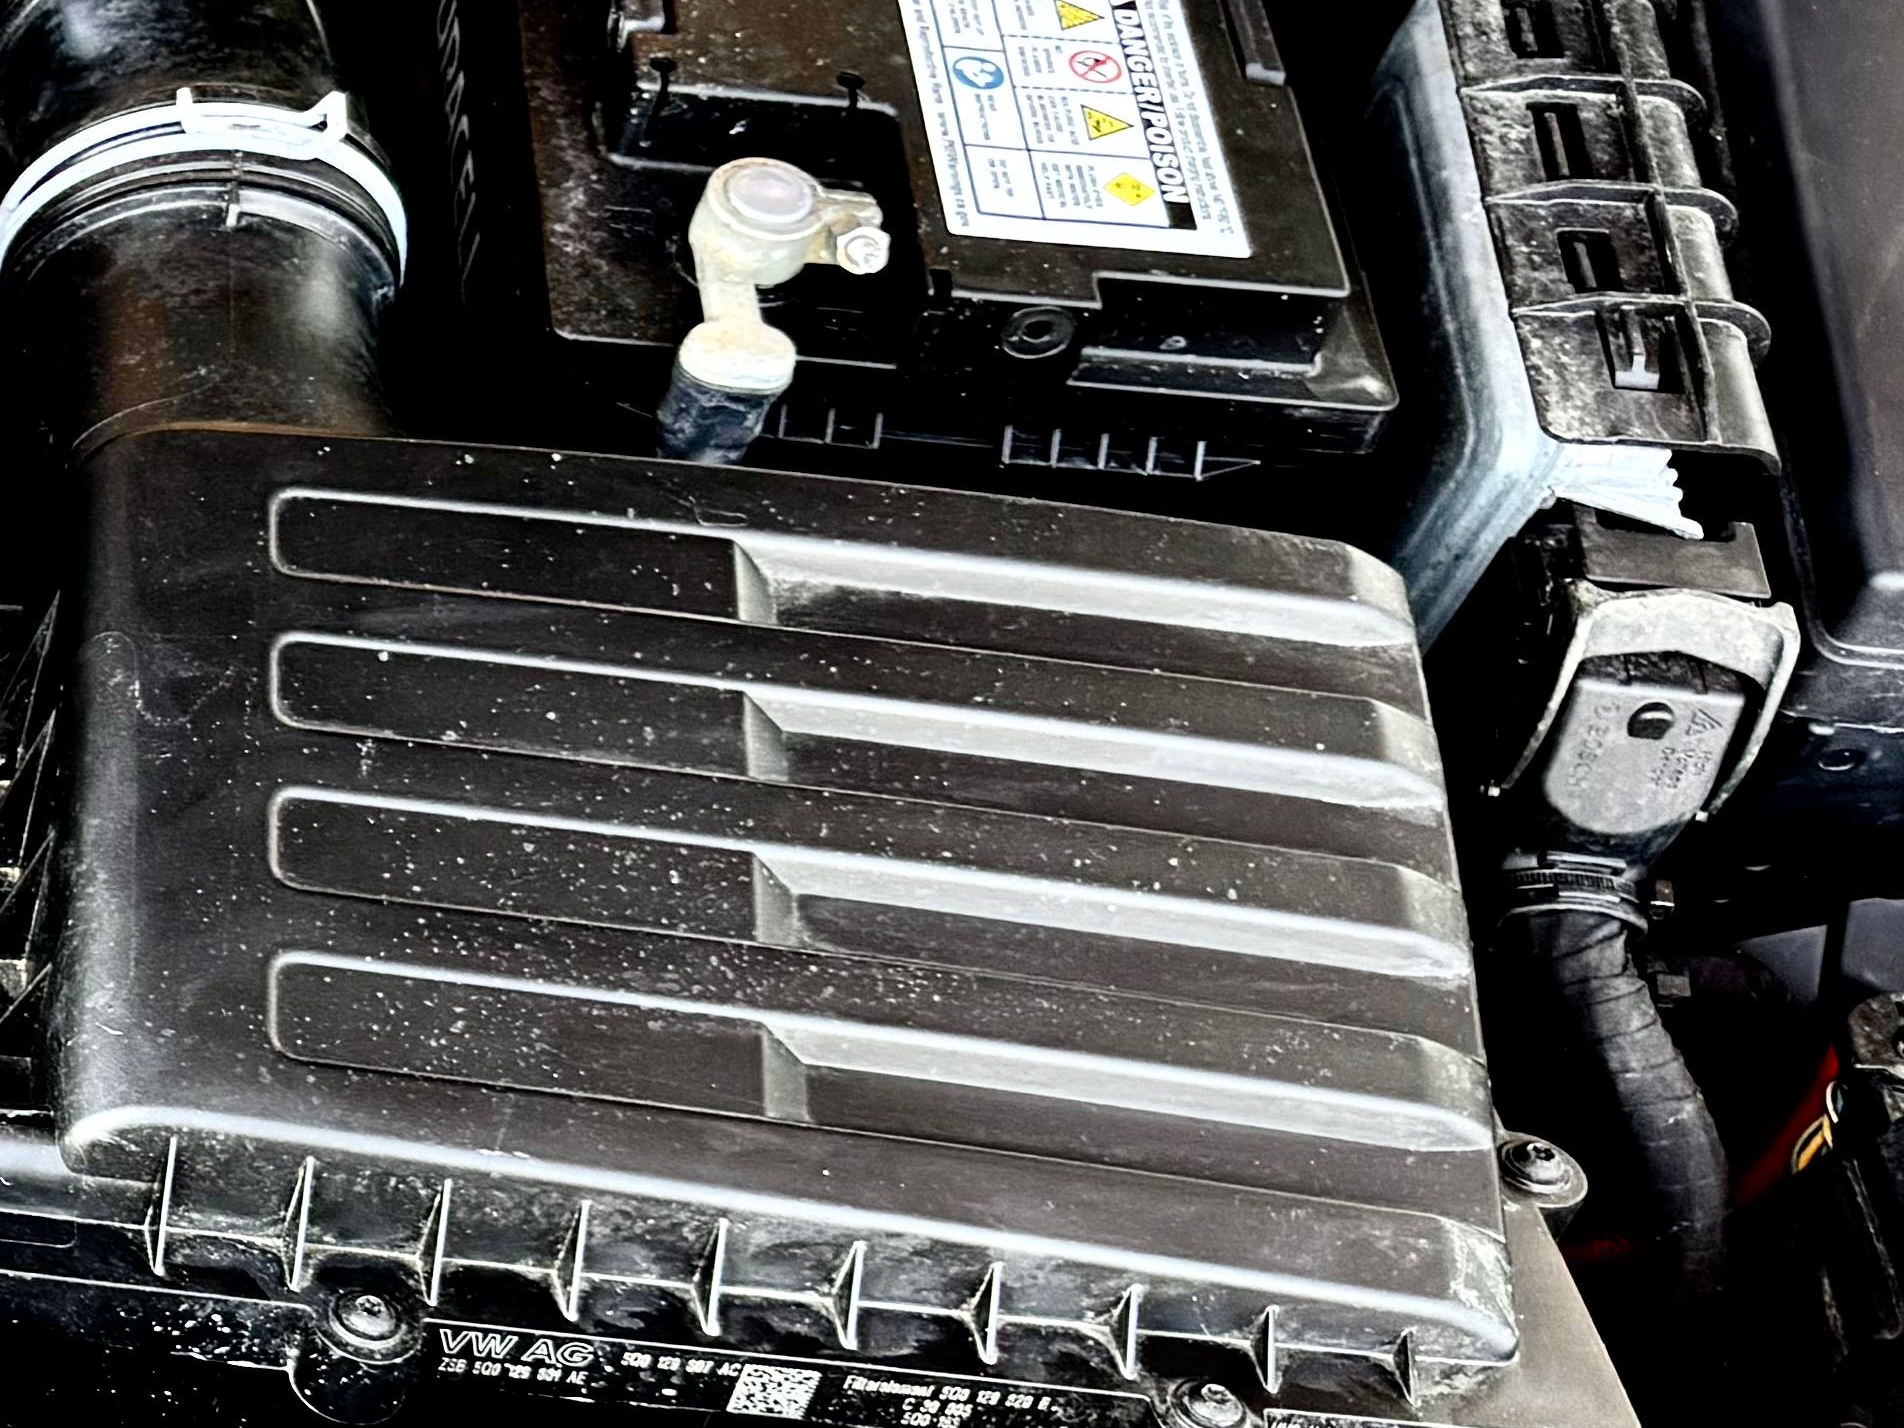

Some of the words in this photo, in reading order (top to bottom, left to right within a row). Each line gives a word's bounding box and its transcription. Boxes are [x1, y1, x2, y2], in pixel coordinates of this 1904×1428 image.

[1115, 3, 1190, 205] DANGER/POISON
[439, 1328, 519, 1359] VW
[520, 1338, 599, 1368] AG
